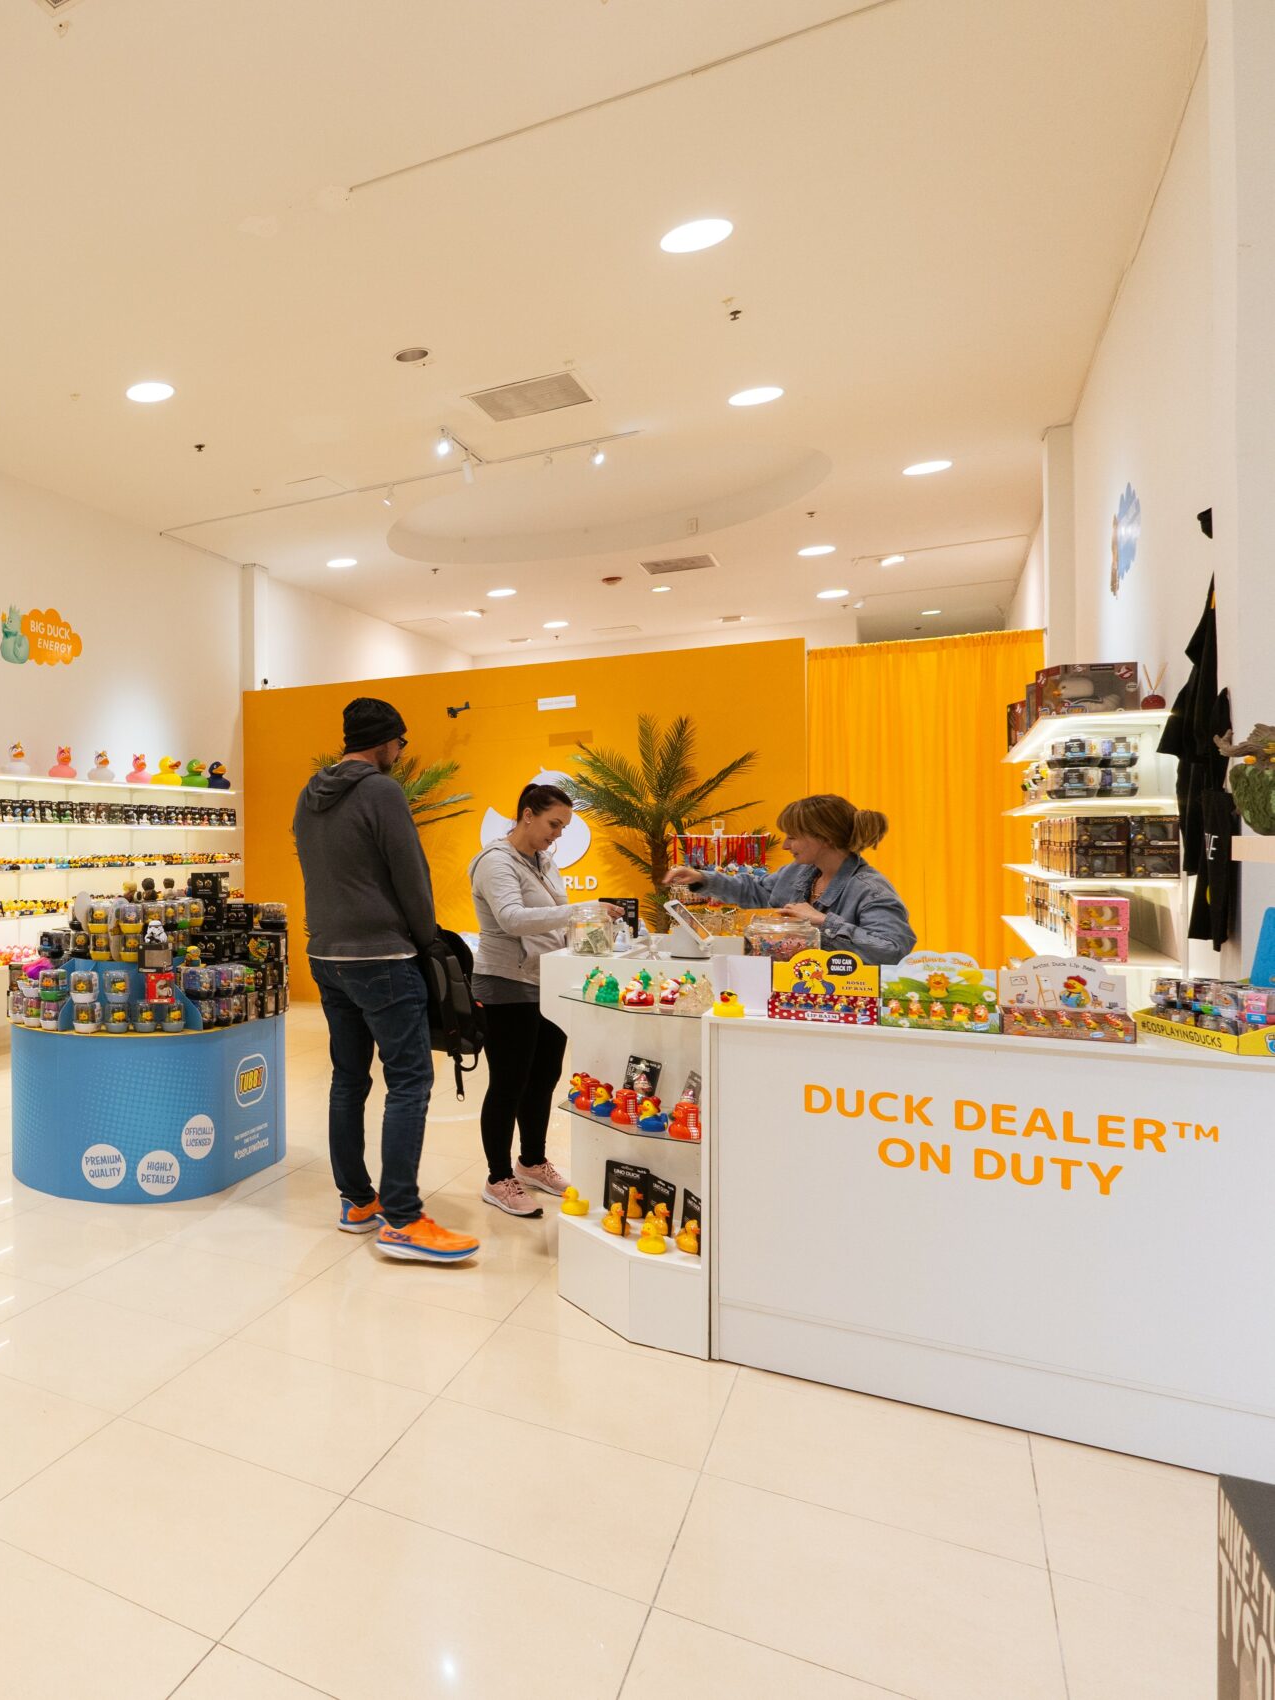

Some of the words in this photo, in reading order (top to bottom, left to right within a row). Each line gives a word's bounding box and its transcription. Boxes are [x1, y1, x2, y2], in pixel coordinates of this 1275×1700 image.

[30, 620, 45, 634] BIG
[46, 623, 71, 640] DUCK
[37, 638, 72, 654] ENERGY
[562, 875, 598, 890] RLD
[1141, 1021, 1222, 1048] #COSPLAYINGDUCKS
[239, 1065, 264, 1095] TUBBZ
[804, 1084, 934, 1127] DUCK
[185, 1126, 213, 1135] OFFICIALLY
[186, 1138, 212, 1147] LICENSED
[85, 1154, 122, 1166] PREMIUM
[146, 1161, 173, 1172] HIGHLY
[877, 1137, 951, 1175] ON
[973, 1148, 1123, 1196] DUTY
[89, 1167, 121, 1179] QUALITY
[140, 1173, 176, 1185] DETAILED
[625, 1171, 640, 1179] DUCK
